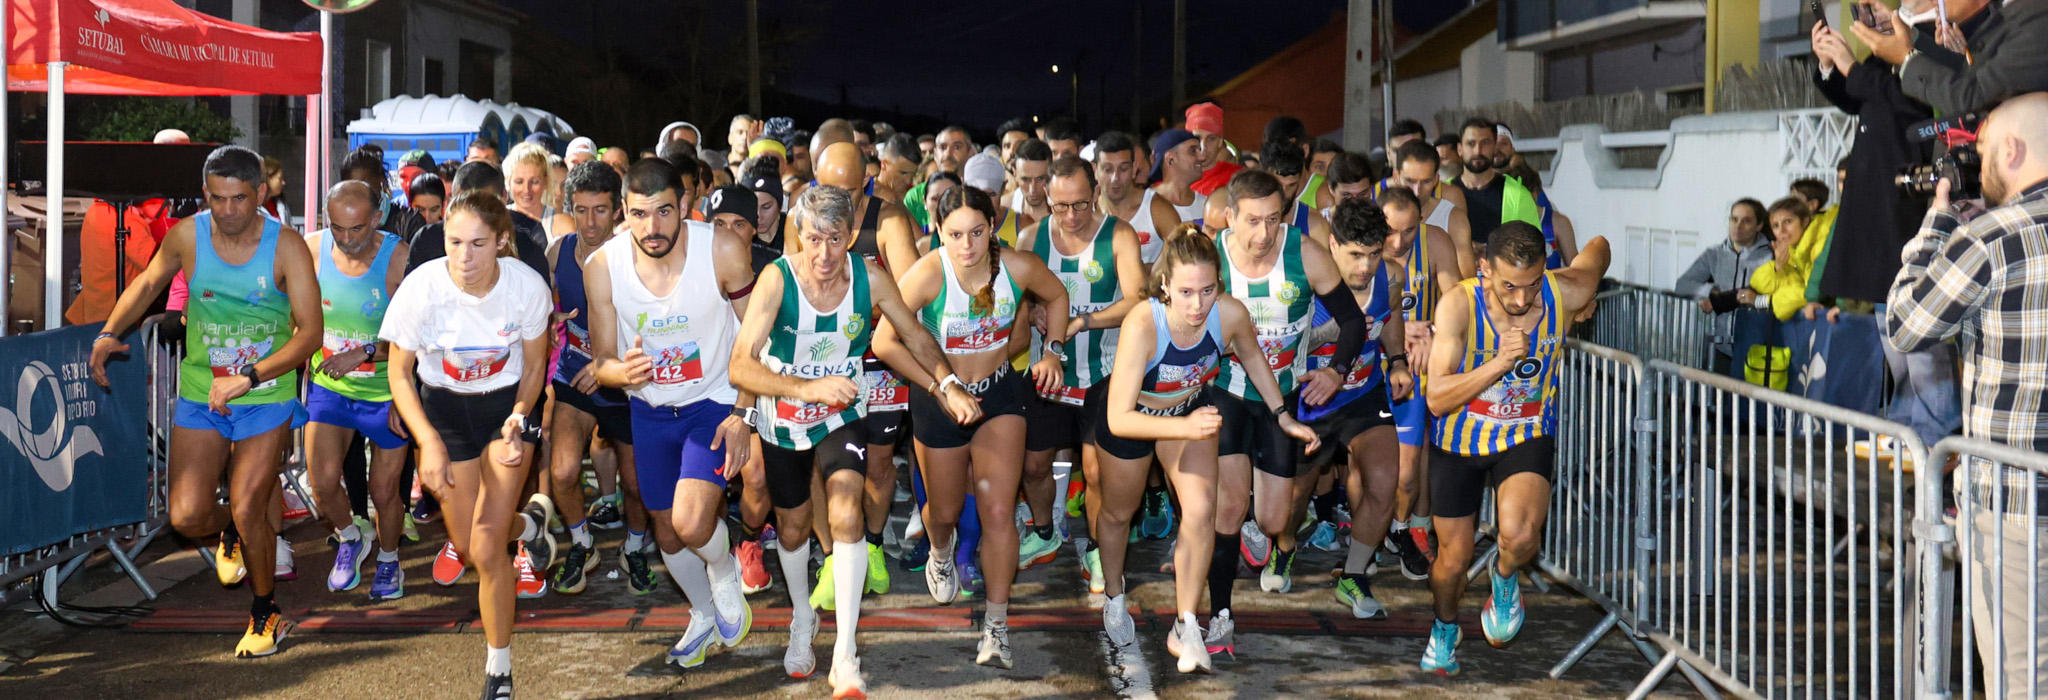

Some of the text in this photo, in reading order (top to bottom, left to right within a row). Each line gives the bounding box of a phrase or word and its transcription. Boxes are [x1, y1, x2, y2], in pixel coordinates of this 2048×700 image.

[229, 46, 240, 63] DE
[653, 315, 689, 328] GFD
[963, 331, 995, 346] 424
[458, 364, 491, 379] 138
[652, 365, 684, 380] 142
[779, 361, 855, 377] ASCENZA
[869, 387, 895, 400] 359
[795, 405, 829, 419] 425
[1488, 403, 1523, 415] 405
